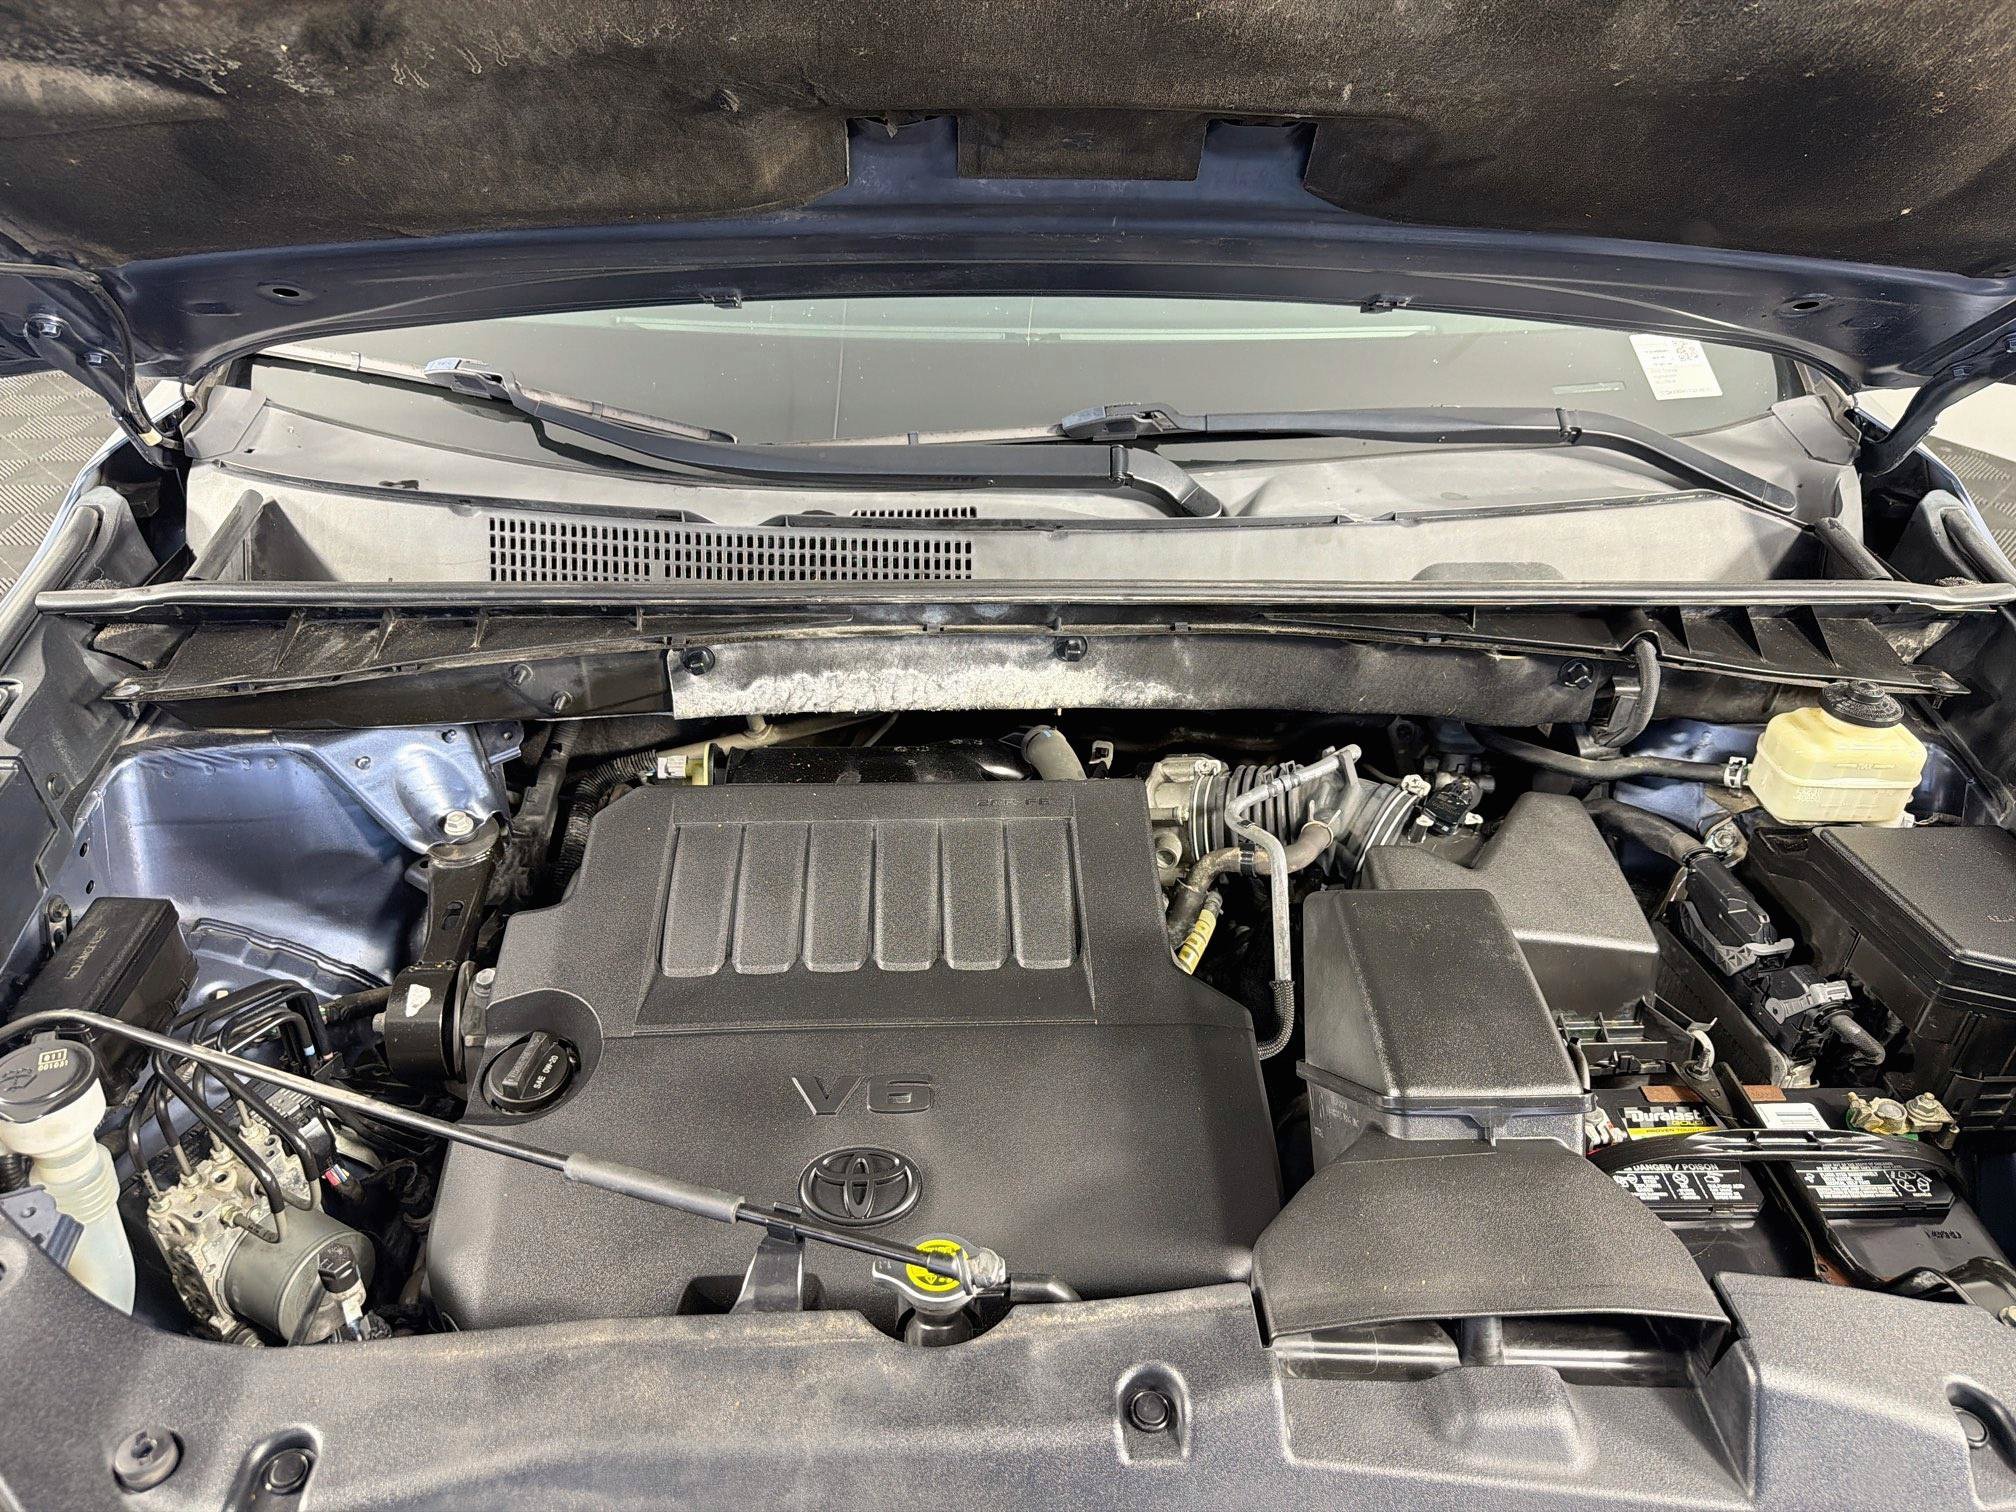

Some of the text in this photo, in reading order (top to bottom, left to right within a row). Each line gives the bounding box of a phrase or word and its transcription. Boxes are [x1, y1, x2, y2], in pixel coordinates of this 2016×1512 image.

[533, 1075, 547, 1089] SAE
[791, 1073, 933, 1115] V6
[1630, 1109, 1702, 1122] Duralast
[1632, 1163, 1674, 1171] DANGER
[1681, 1163, 1719, 1171] POISON
